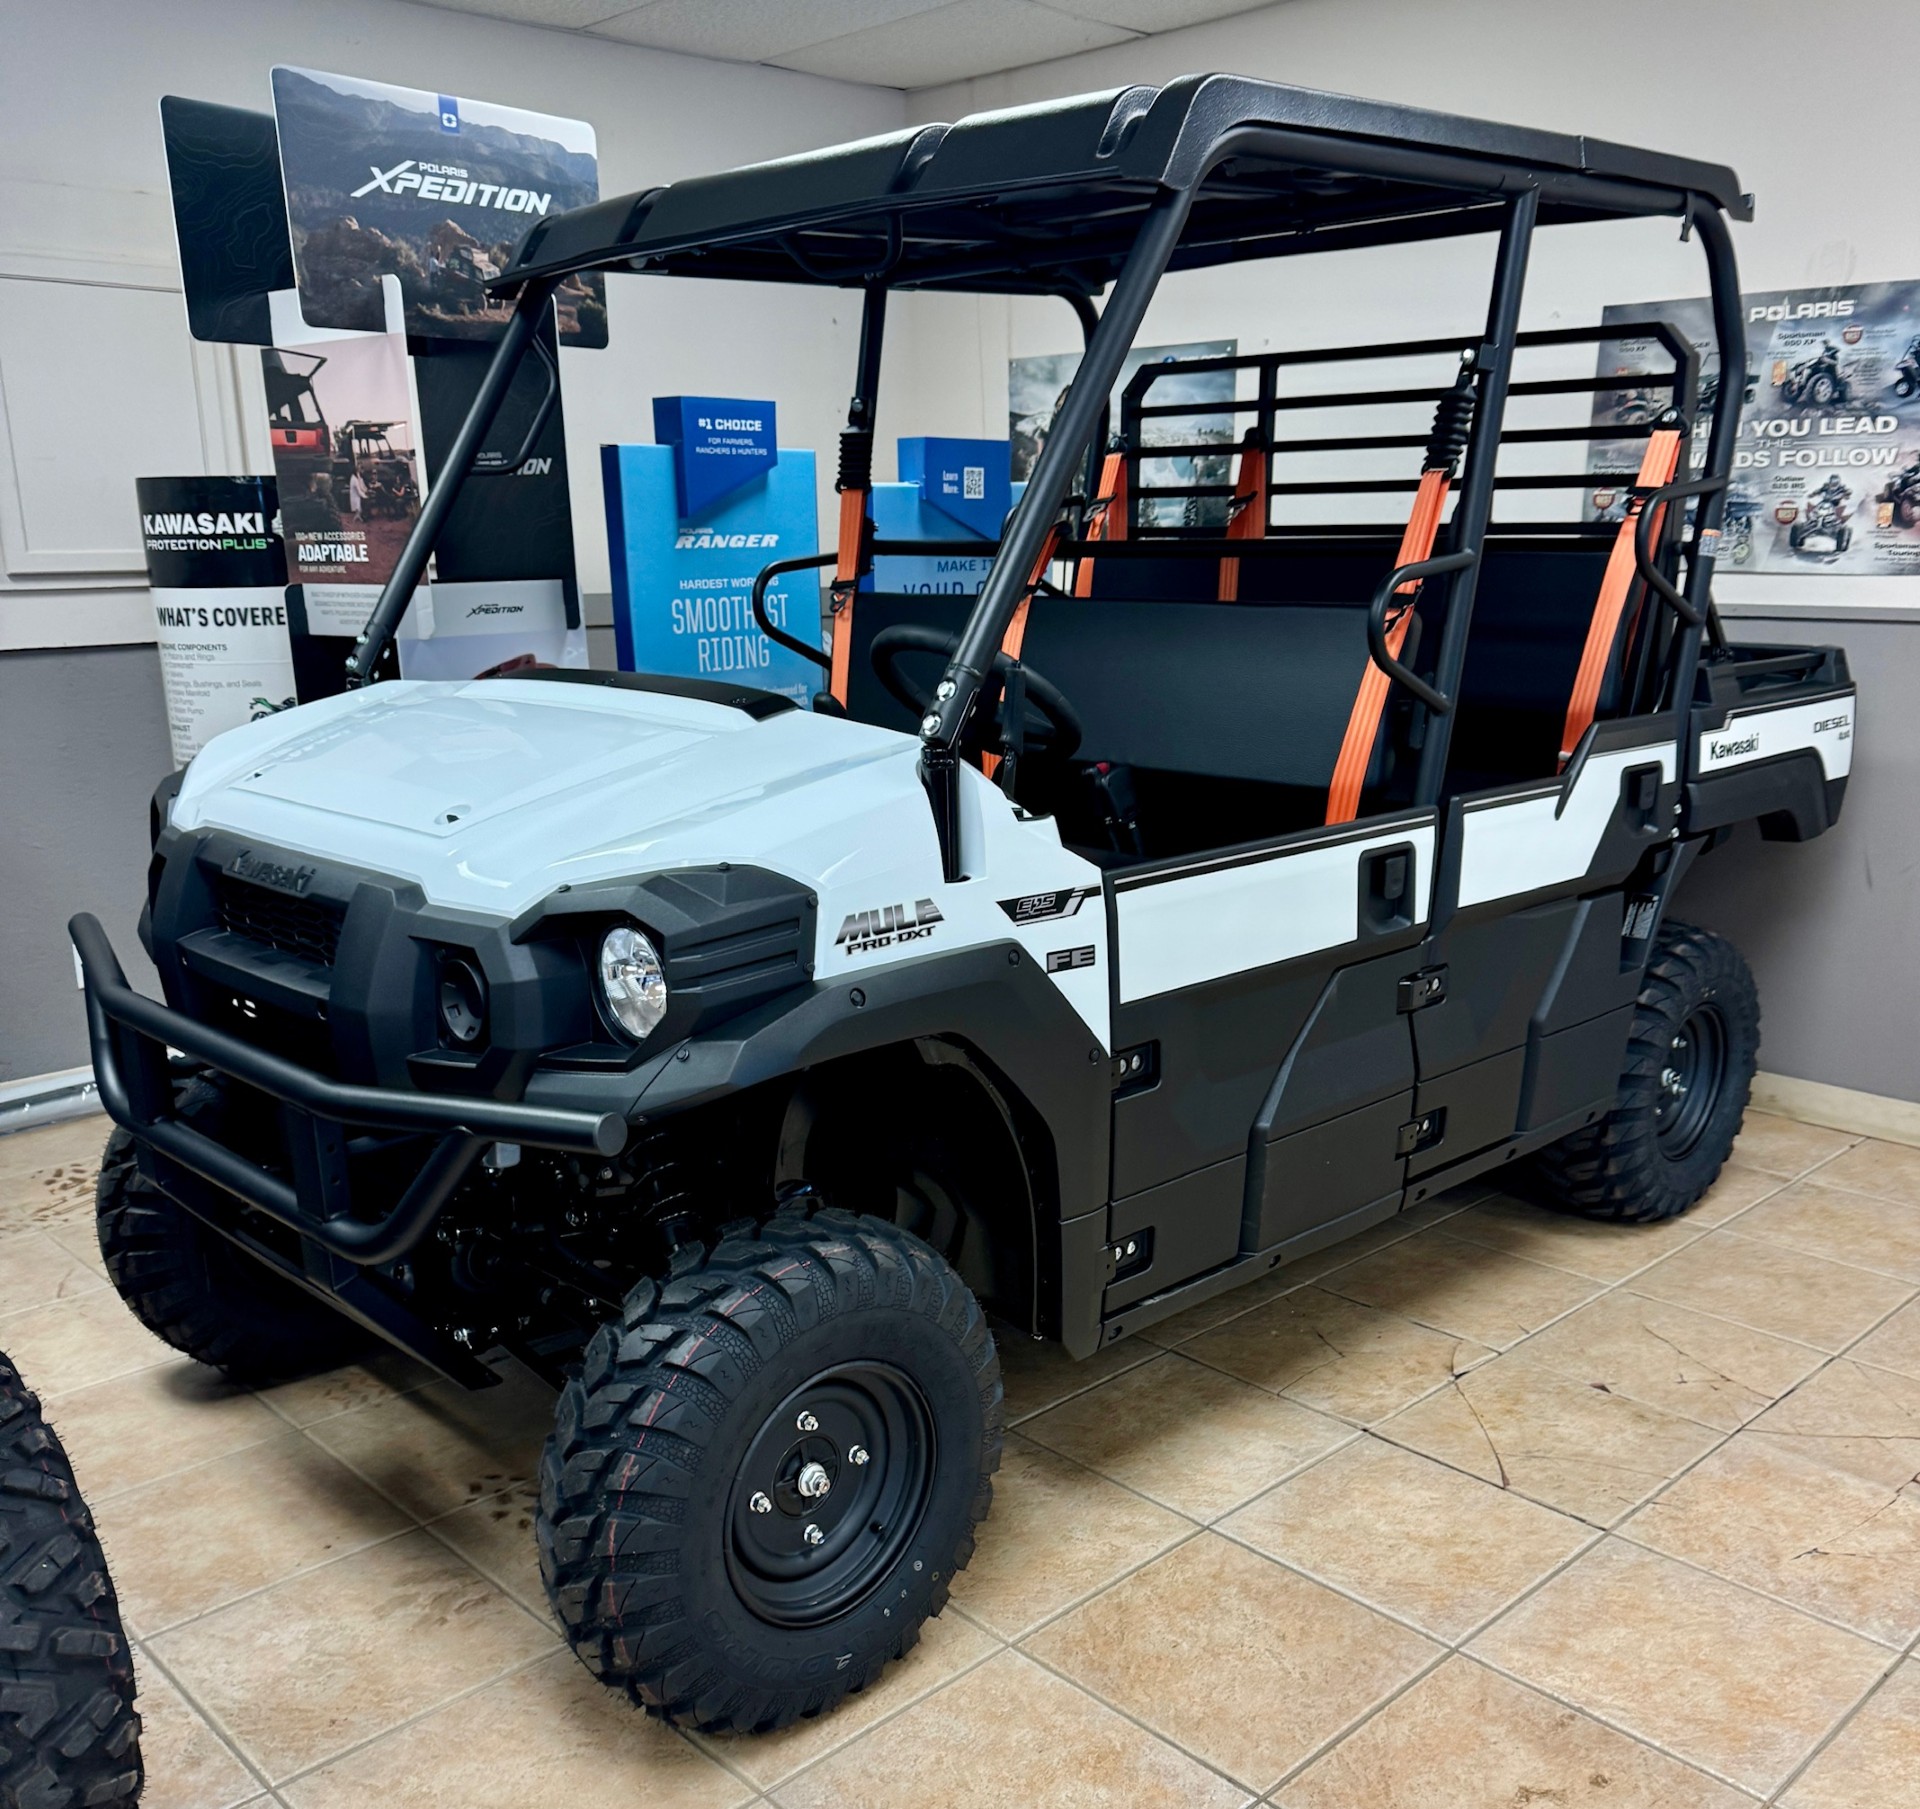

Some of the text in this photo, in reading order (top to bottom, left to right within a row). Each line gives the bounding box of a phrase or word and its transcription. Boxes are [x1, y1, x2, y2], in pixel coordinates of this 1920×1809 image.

[418, 161, 469, 179] POLARIS
[350, 159, 552, 216] XPEDITION
[1748, 299, 1855, 323] POLARIS
[698, 418, 763, 431] #1 CHOICE
[1752, 418, 1811, 438] YOU
[1818, 415, 1898, 436] LEAD
[708, 437, 721, 445] FOR
[1757, 439, 1792, 448] THE
[696, 447, 730, 455] RANCHERS
[738, 448, 768, 456] HUNTERS
[1778, 447, 1899, 468] FOLLOW
[143, 512, 265, 535] KAWASAKI
[324, 532, 366, 541] ACCESSORIES
[675, 534, 779, 549] RANGER
[298, 544, 369, 562] ADAPTABLE
[937, 560, 977, 572] MAKE
[680, 578, 729, 589] HARDEST
[157, 606, 209, 627] WHAT'S
[466, 604, 524, 618] XPEDITION
[671, 593, 789, 634] SMOOTHST
[178, 643, 227, 651] COMPONENTS
[698, 634, 770, 673] RIDING
[1813, 714, 1851, 733] DIESEL
[1710, 733, 1760, 760] Kawasaki
[834, 898, 944, 945] MULE
[845, 925, 936, 956] PRO-DXT
[1048, 949, 1094, 970] FE
